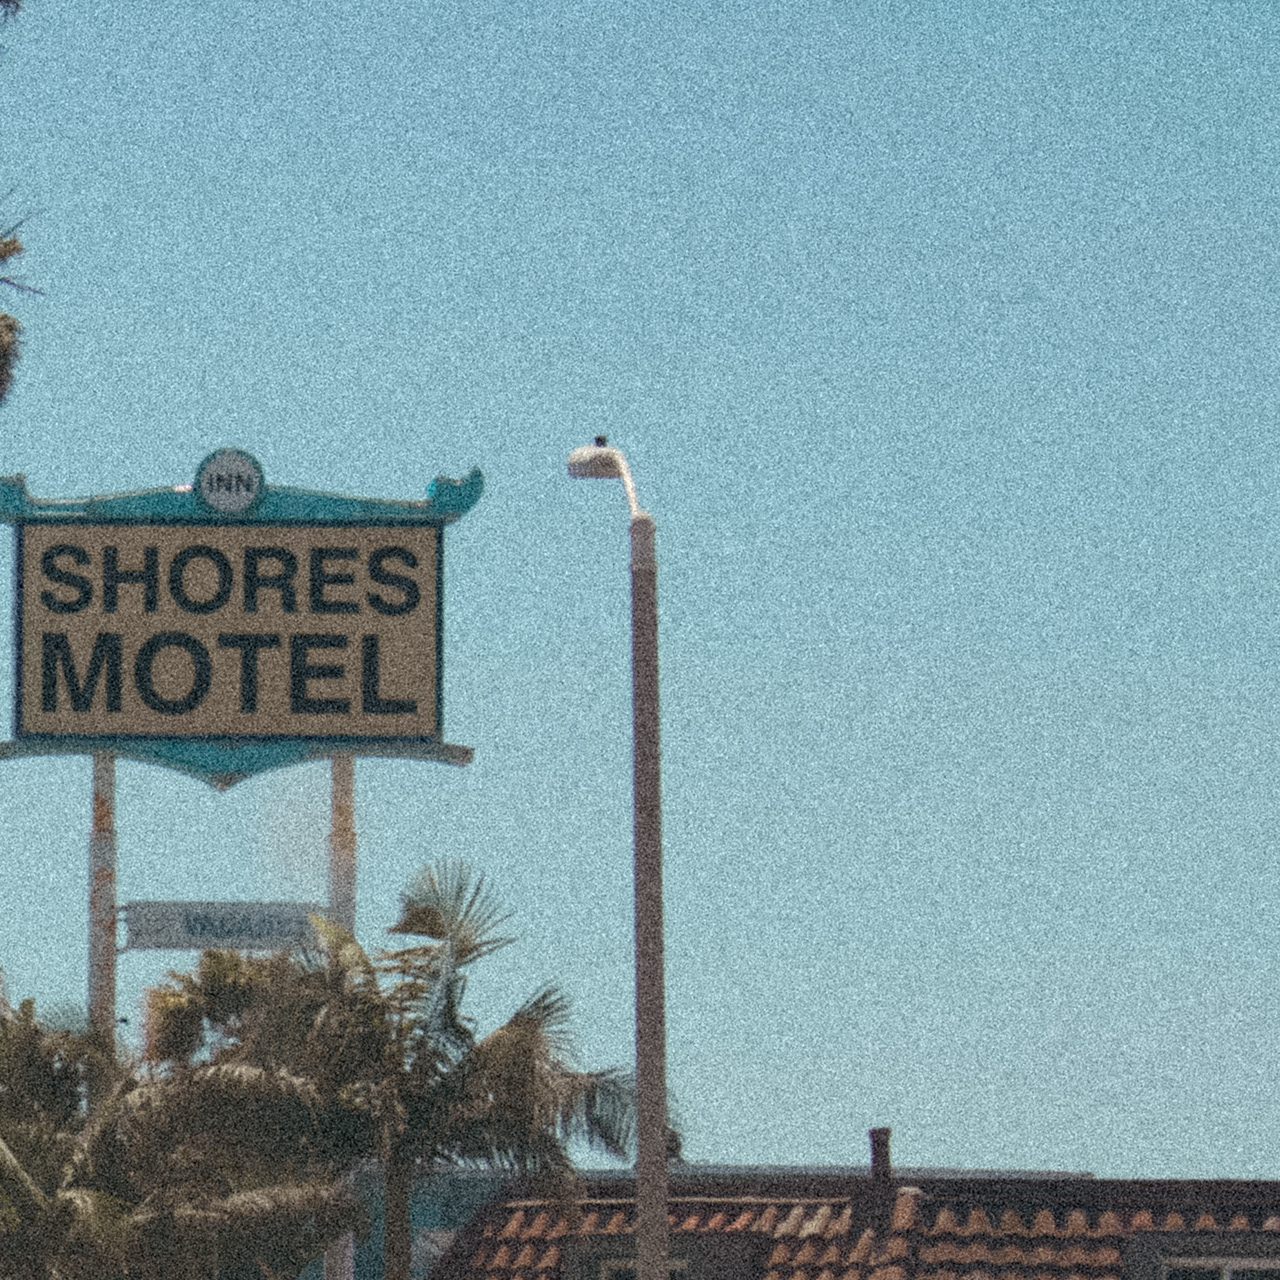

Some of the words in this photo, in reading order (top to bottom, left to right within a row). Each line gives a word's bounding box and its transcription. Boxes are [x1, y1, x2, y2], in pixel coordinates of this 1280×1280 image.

[207, 474, 254, 495] INN
[40, 544, 422, 616] SHORES
[40, 631, 418, 716] MOTEL
